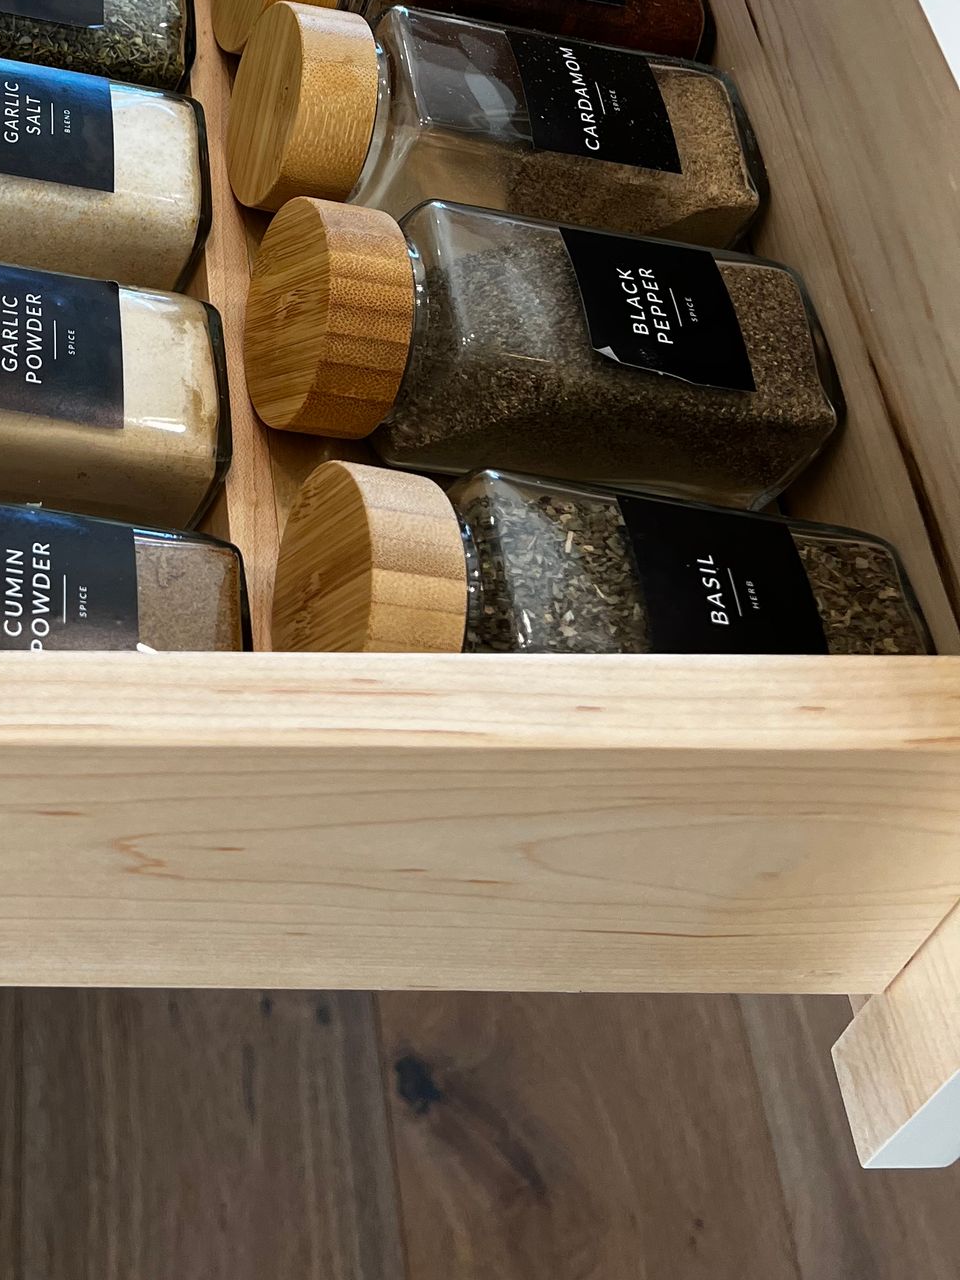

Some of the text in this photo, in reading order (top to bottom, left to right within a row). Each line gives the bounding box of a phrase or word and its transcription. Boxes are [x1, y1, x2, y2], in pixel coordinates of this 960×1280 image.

[3, 81, 20, 143] GARLIC
[25, 94, 41, 136] SALT
[63, 109, 71, 134] BLEND
[559, 46, 600, 151] CARDAMOM
[608, 89, 621, 112] SPICE
[616, 268, 650, 335] BLACK
[638, 268, 674, 345] PEPPER
[684, 297, 699, 323] SPICE
[1, 295, 19, 372] GARLIC
[25, 293, 43, 384] POWDER
[67, 329, 76, 356] SPICE
[3, 548, 24, 637] CUMIN
[78, 585, 88, 618] SPICE
[696, 554, 730, 625] BASIL
[745, 580, 760, 610] HERB
